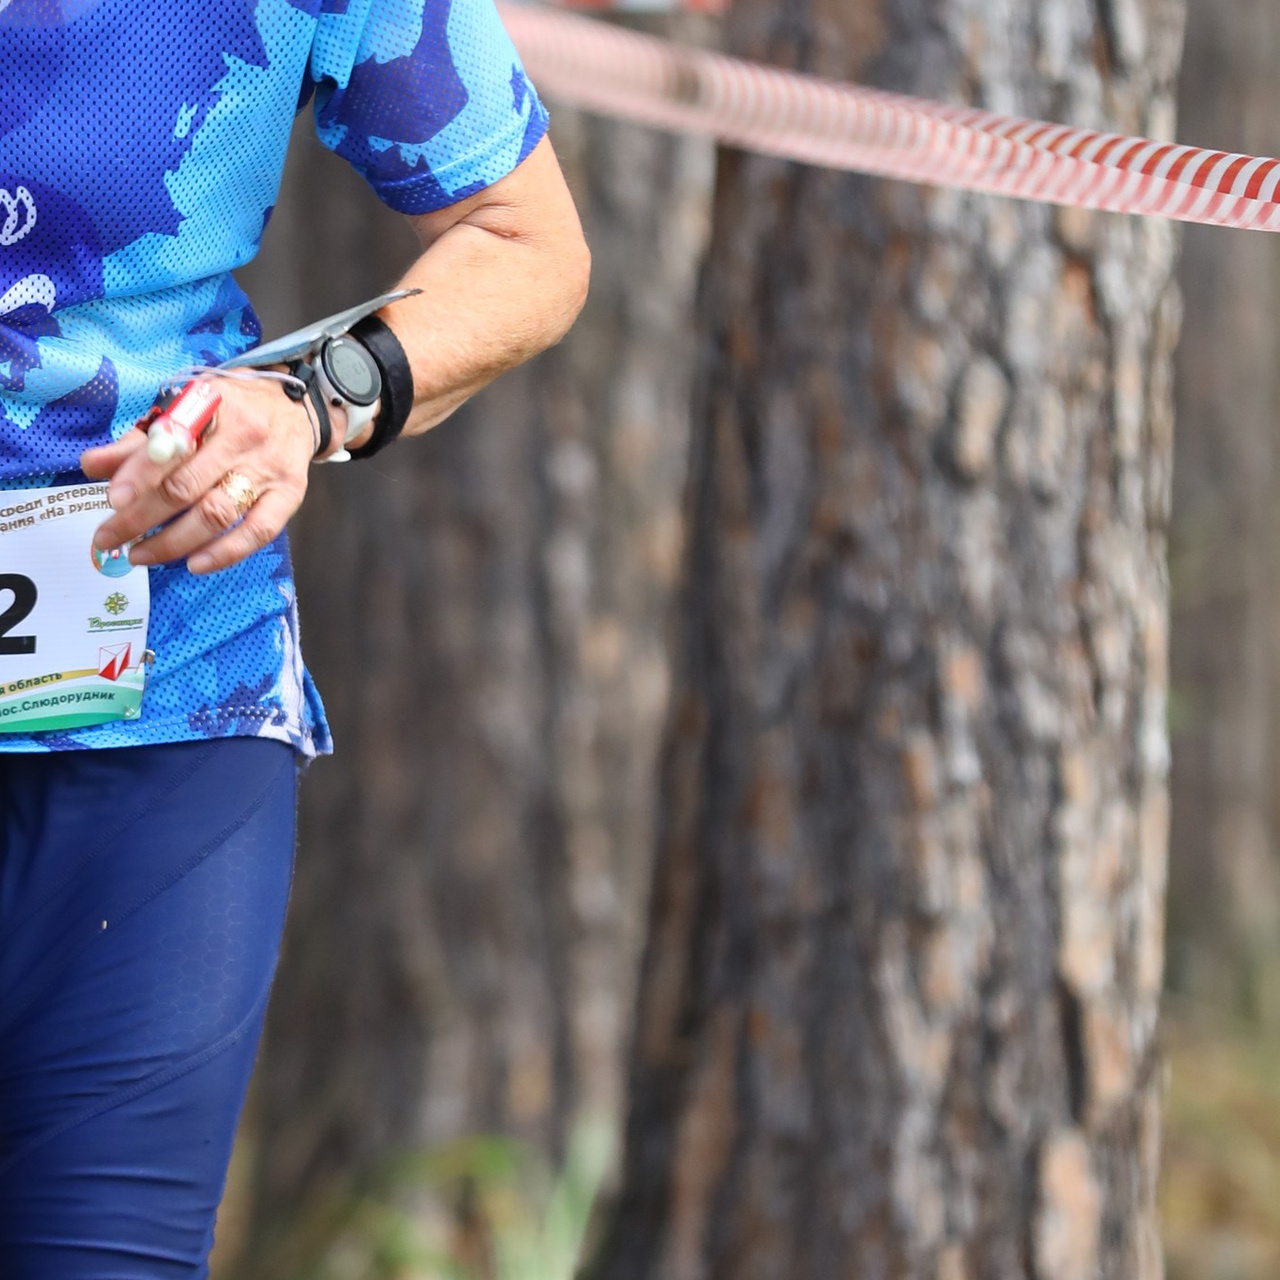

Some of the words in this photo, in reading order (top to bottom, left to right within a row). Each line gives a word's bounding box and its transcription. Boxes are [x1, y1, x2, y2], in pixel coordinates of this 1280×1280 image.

[0, 498, 43, 518] среди
[39, 505, 64, 521] «На
[8, 672, 63, 692] область
